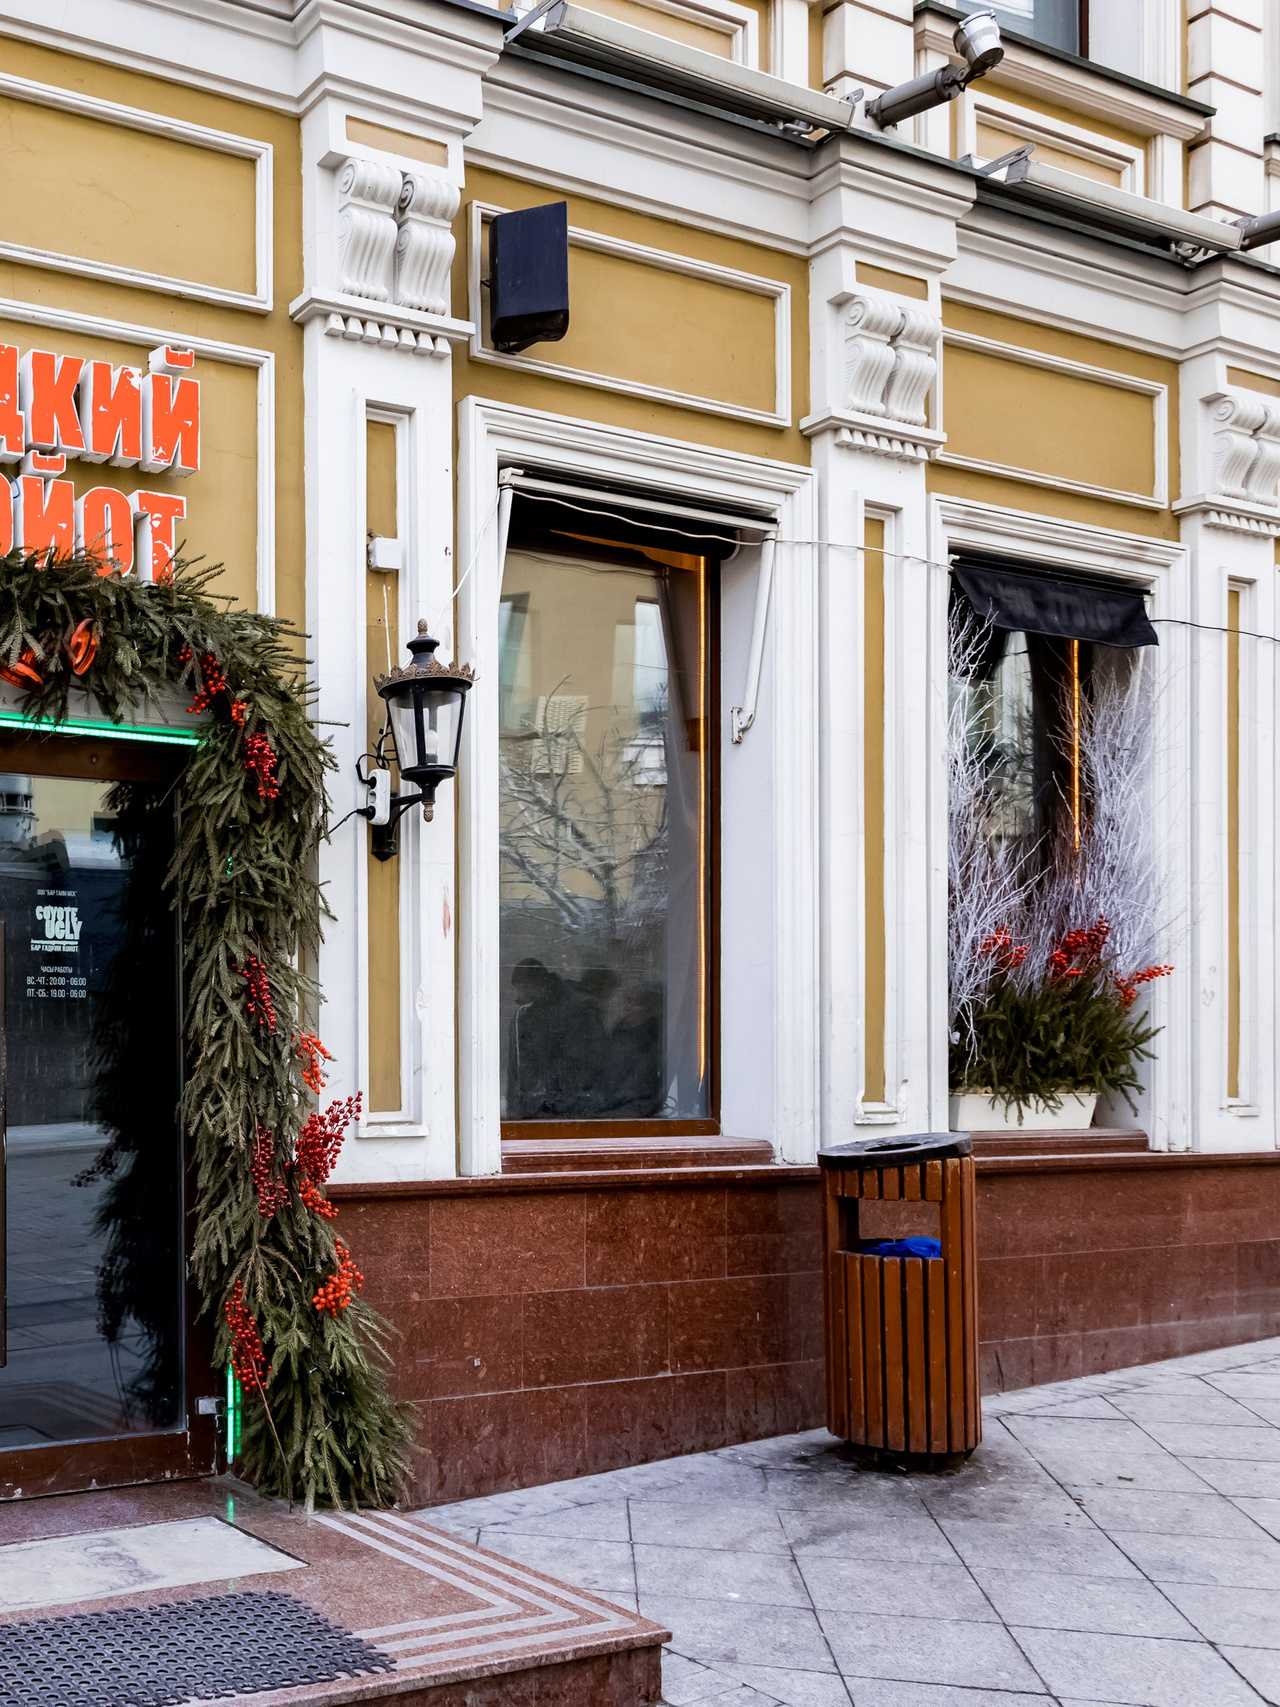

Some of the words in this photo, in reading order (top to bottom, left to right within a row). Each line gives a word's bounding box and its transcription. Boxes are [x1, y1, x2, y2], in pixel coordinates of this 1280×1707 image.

[35, 905, 78, 921] COYOTE
[45, 919, 83, 940] UGLY
[54, 966, 72, 974] РАБОТЫ
